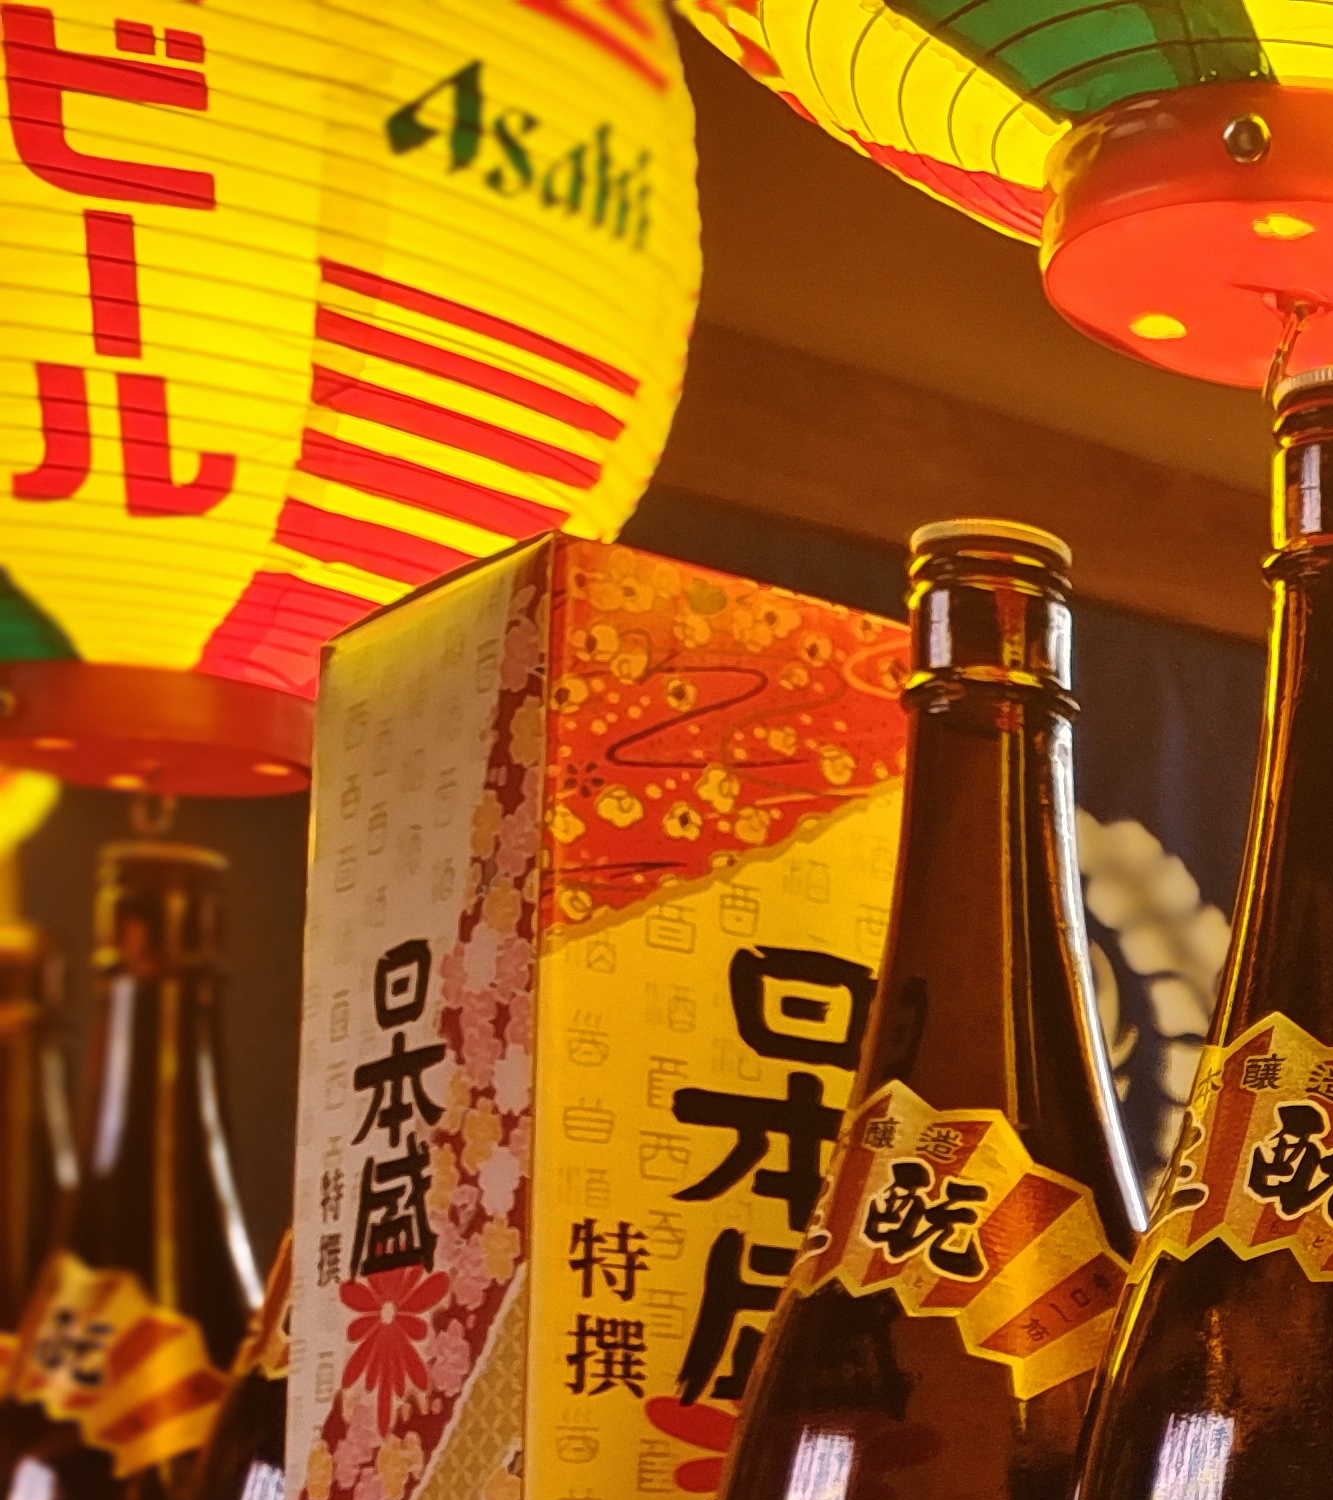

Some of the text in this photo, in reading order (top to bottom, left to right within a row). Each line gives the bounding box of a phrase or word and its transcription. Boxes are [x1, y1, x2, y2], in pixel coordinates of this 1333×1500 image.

[384, 58, 652, 252] Asahi
[2, 4, 237, 517] ビール
[350, 940, 447, 1284] 日本盛
[565, 1217, 651, 1399] 特撰
[808, 1162, 988, 1279] 酛
